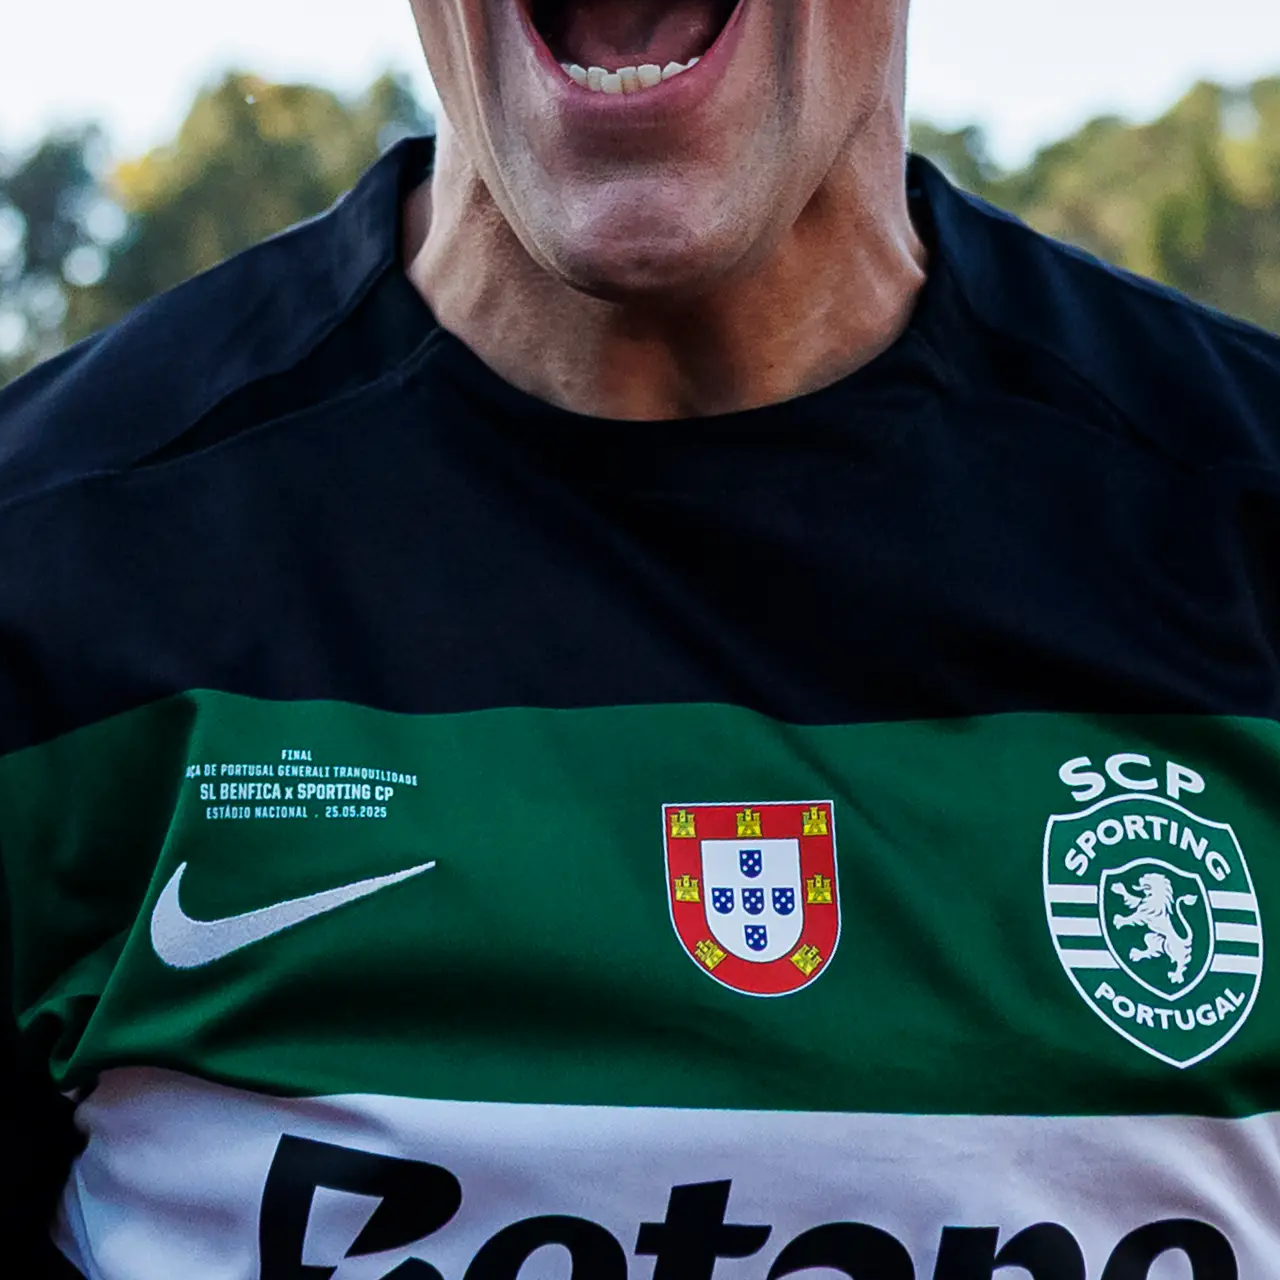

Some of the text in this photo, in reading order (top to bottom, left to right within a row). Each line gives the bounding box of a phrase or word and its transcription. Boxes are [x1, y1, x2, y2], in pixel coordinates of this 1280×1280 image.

[281, 749, 312, 761] FINAL
[204, 763, 217, 776] DE
[220, 763, 274, 777] PORTUGAL
[277, 764, 330, 778] GENERALI
[333, 766, 418, 786] TRANQUILIDADE
[1058, 753, 1206, 801] SCP
[200, 783, 217, 800] SL
[220, 783, 282, 800] BENFICA
[297, 783, 371, 800] SPORTING
[375, 785, 394, 801] CP
[206, 805, 251, 819] ESTÁDIO
[254, 806, 308, 819] NACIONAL
[325, 805, 387, 818] 25.05.2025
[1064, 814, 1231, 882] SPORTING
[1094, 982, 1246, 1031] PORTUGAL
